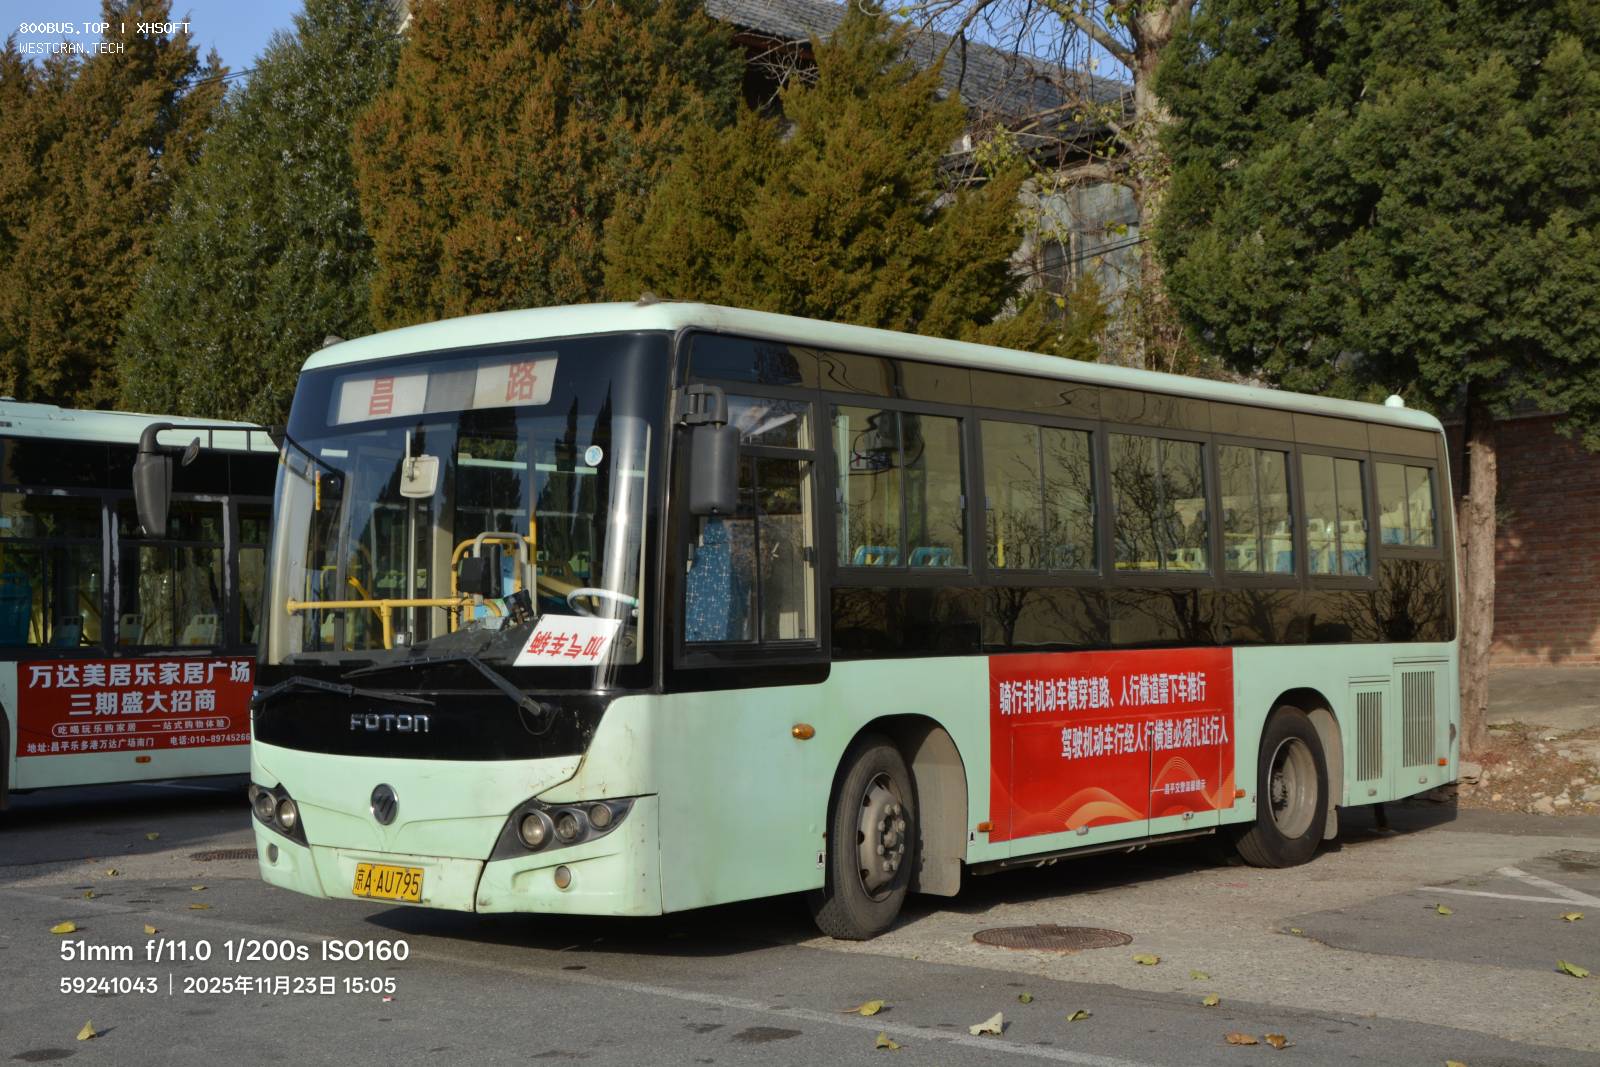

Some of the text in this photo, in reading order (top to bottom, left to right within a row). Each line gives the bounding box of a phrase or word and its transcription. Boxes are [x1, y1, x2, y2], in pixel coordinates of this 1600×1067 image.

[368, 360, 538, 416] 昌 路
[526, 630, 608, 661] 加气车辆
[28, 660, 251, 689] 万达美居乐家居广场
[68, 689, 216, 717] 三期盛大招商
[151, 718, 226, 731] 一站式购物体验
[349, 713, 431, 734] FOTON
[1061, 715, 1228, 760] 驾驶机动车行经人行横道必须礼让行人
